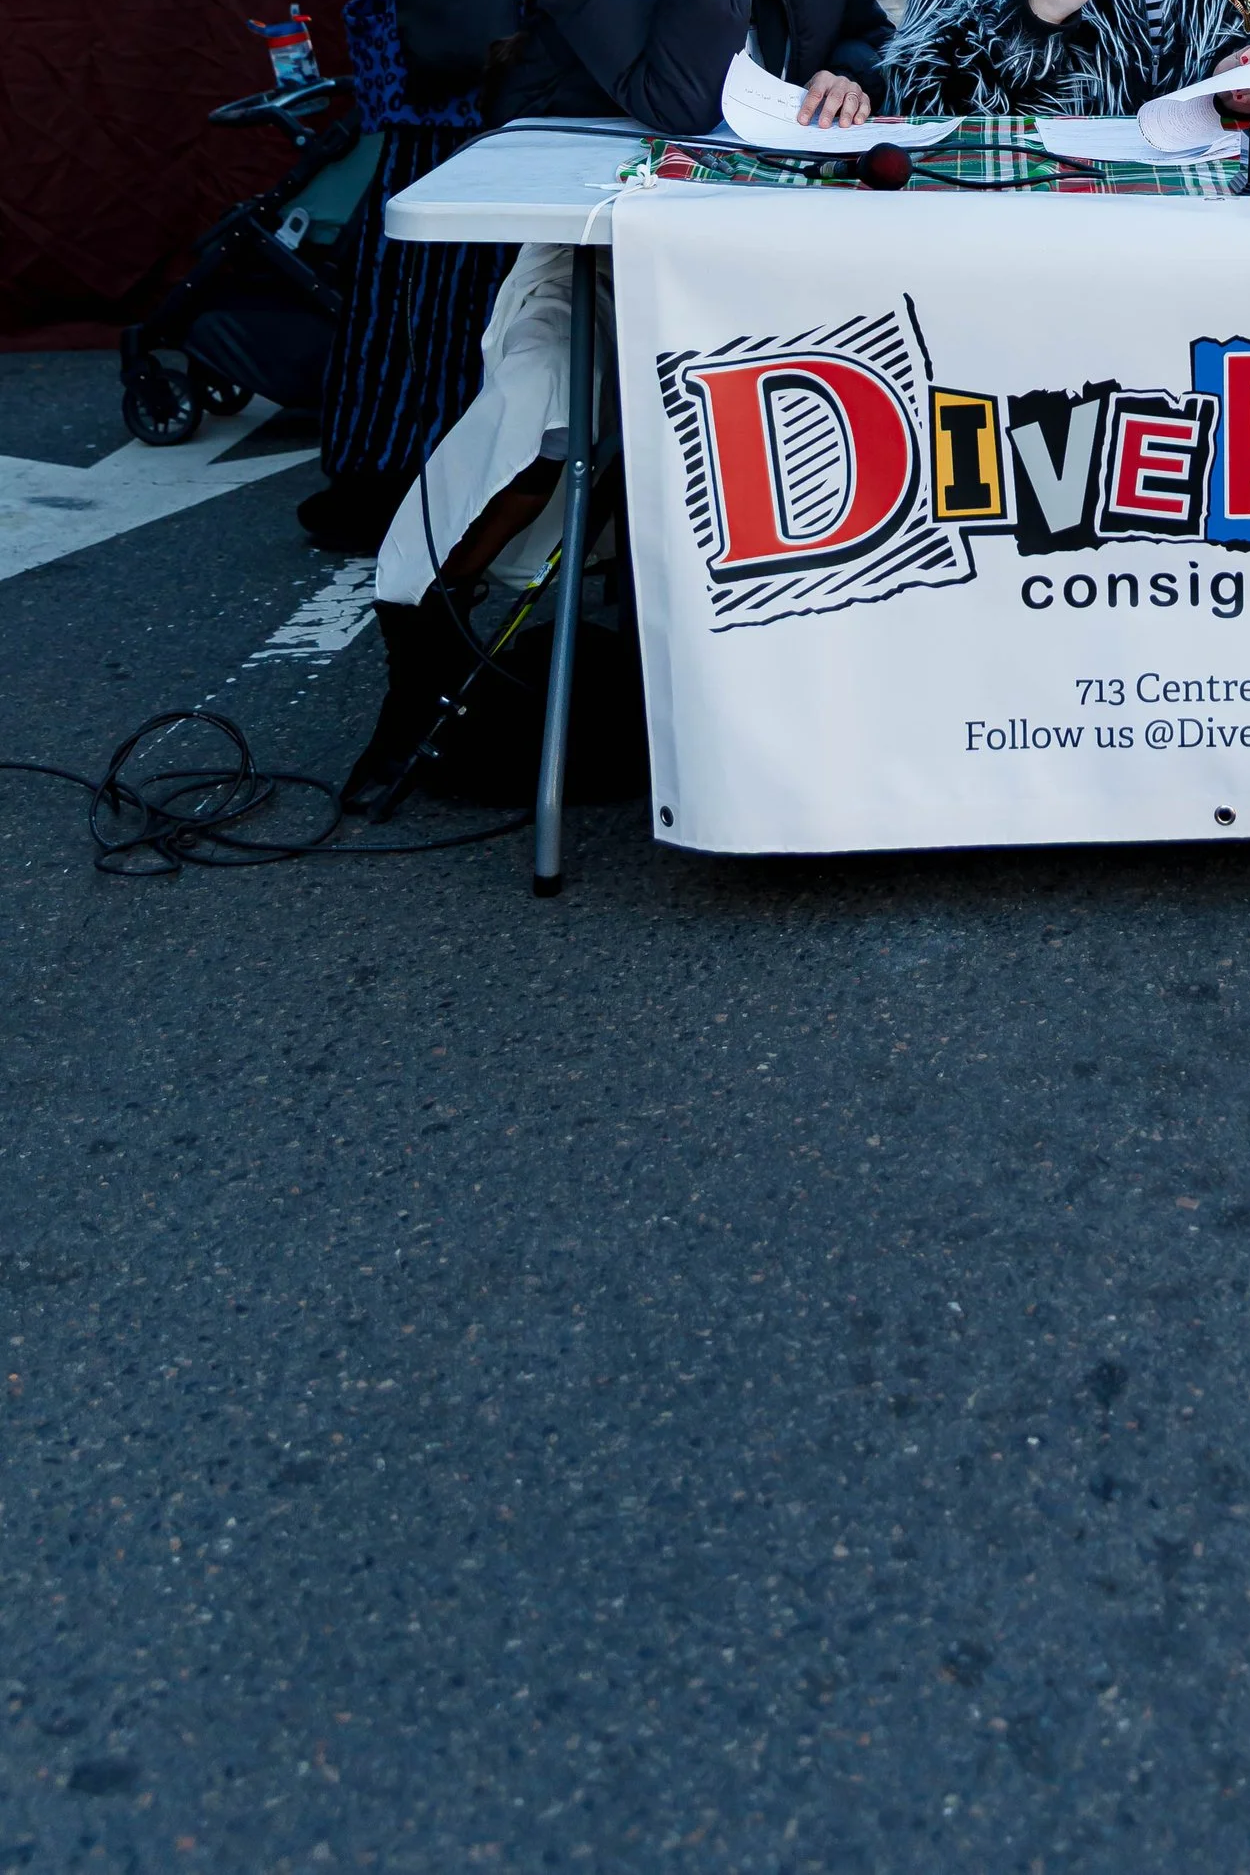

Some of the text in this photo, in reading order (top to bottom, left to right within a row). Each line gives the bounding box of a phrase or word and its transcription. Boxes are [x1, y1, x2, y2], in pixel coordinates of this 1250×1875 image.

[1075, 678, 1126, 706] 713
[964, 718, 1085, 751] Follow
[1094, 726, 1134, 749] us
